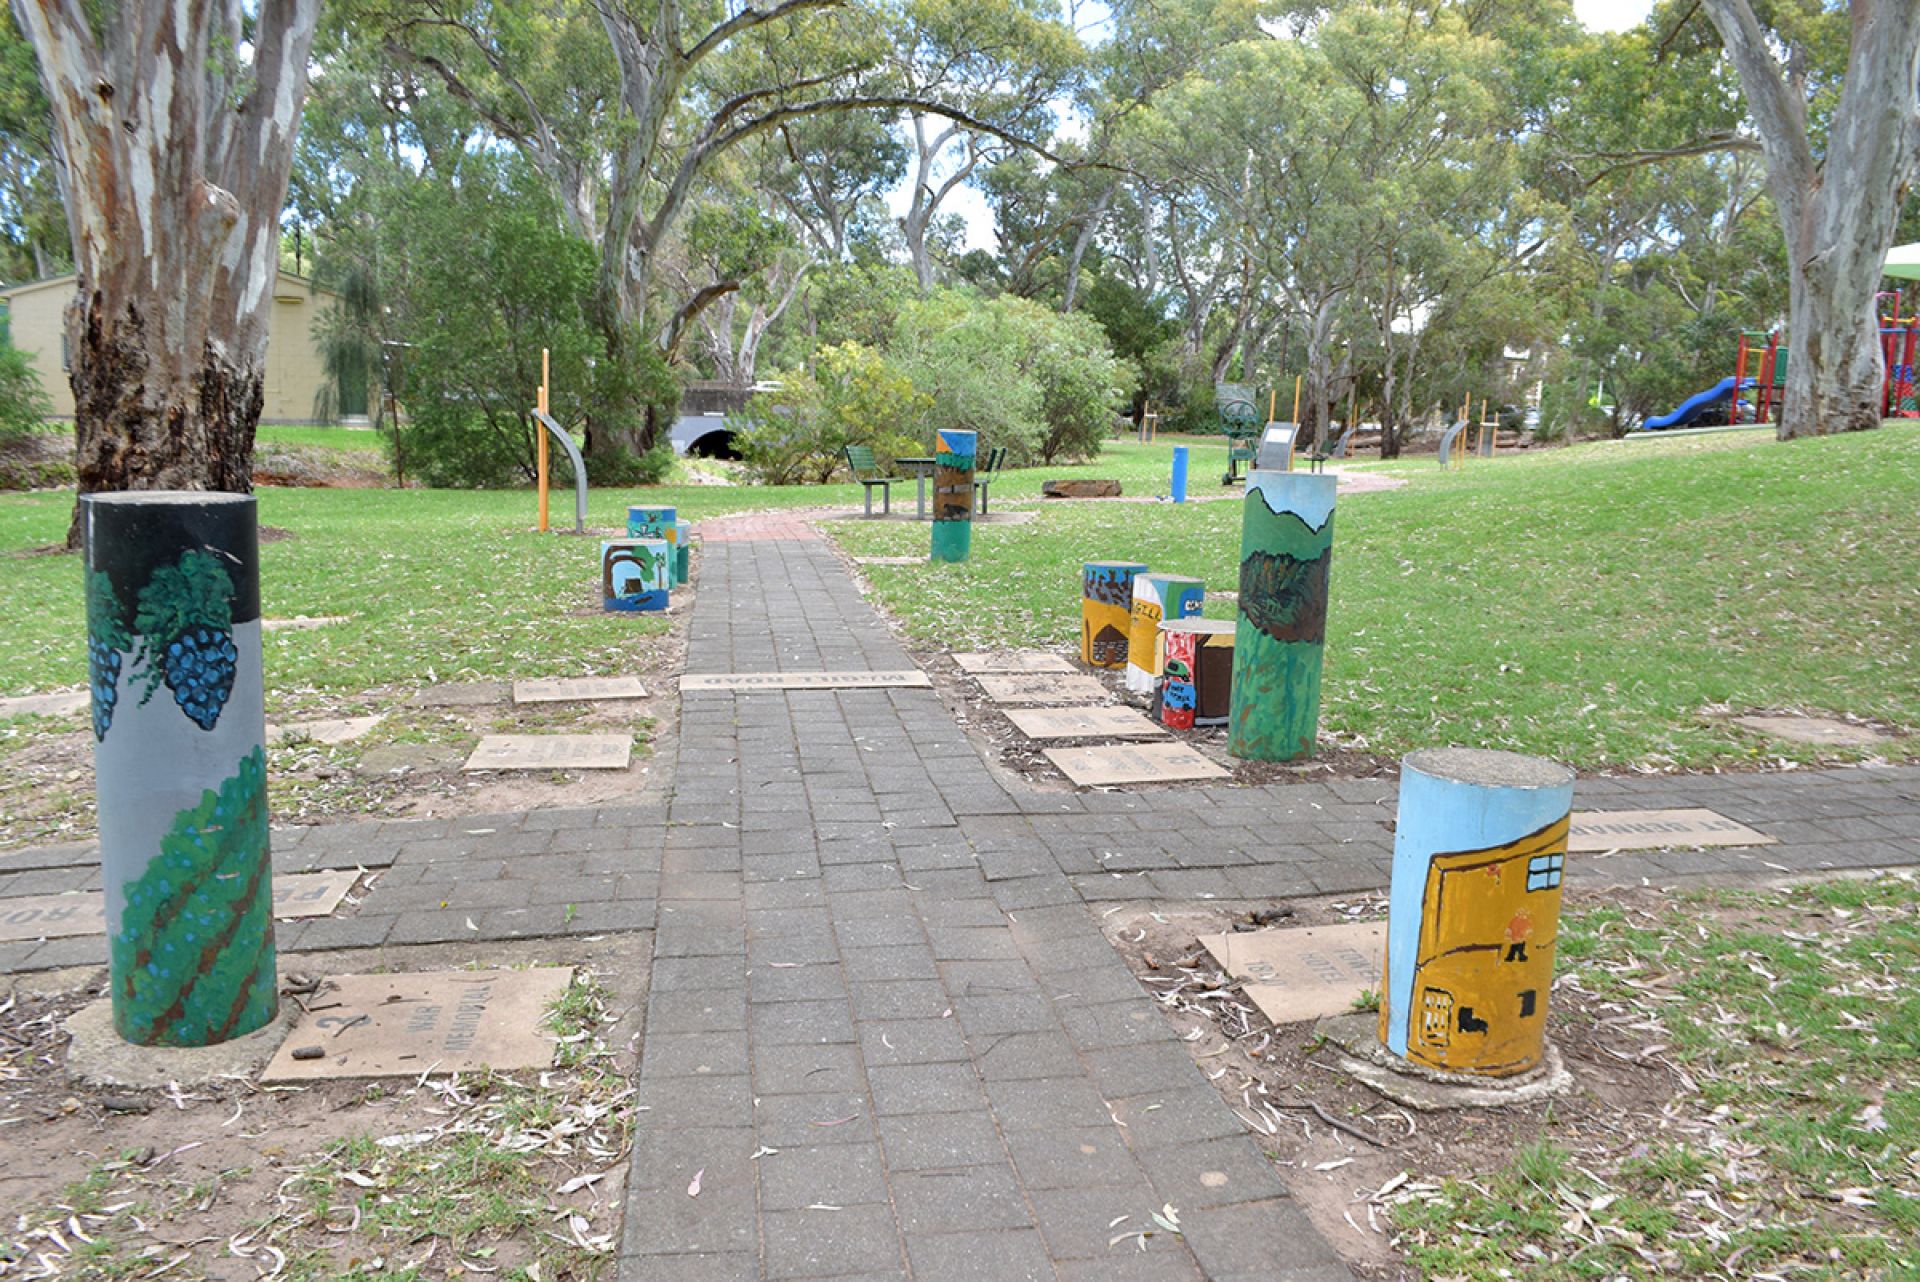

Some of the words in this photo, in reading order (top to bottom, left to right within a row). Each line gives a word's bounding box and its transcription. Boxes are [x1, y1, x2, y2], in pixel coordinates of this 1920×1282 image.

[703, 676, 785, 685] ROAD
[799, 674, 906, 683] MAGILL
[1698, 820, 1740, 832] ST
[405, 1004, 443, 1034] WAR
[442, 984, 491, 1051] MEMORIAL
